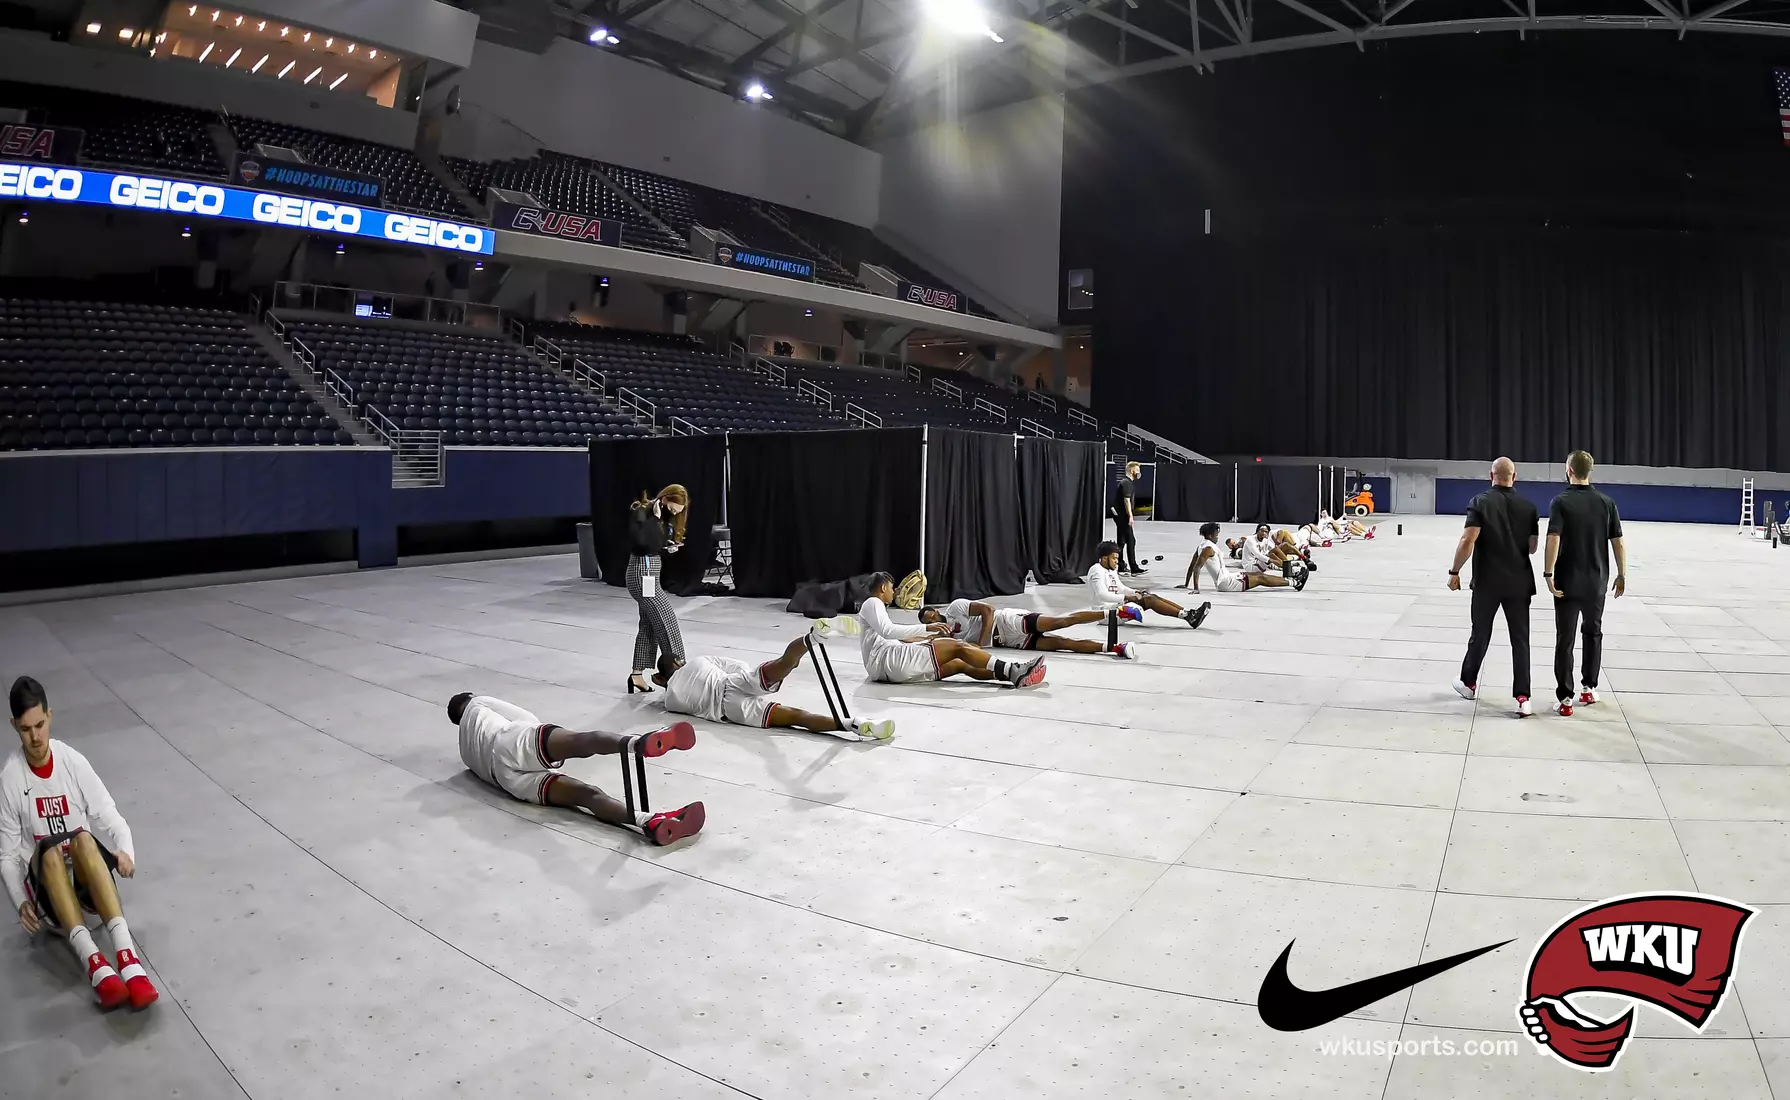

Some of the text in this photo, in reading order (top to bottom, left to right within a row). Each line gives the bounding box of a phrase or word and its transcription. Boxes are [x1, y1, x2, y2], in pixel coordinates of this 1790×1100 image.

[265, 167, 379, 197] #HOOPSATTHESTAR
[110, 175, 225, 216] GEICO
[252, 193, 362, 234] GEICO
[384, 213, 483, 252] GEICO
[736, 252, 810, 276] #HOOPSATTHESTAR
[41, 797, 65, 817] JUST
[49, 817, 65, 834] US
